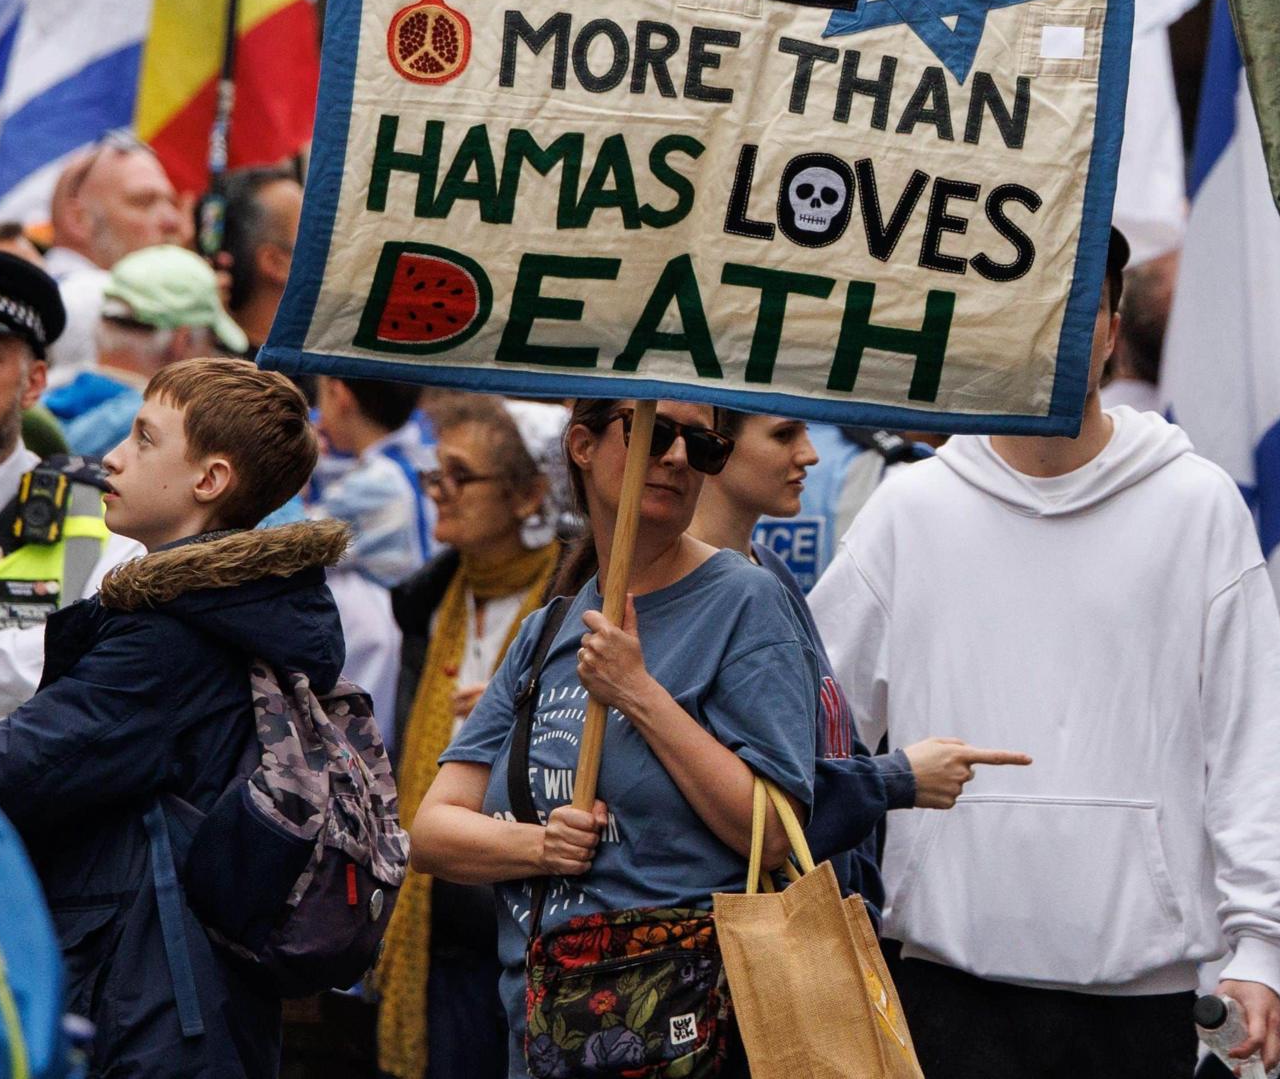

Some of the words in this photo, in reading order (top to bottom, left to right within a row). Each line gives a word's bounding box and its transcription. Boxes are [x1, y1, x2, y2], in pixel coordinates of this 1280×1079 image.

[498, 9, 742, 104] MORE
[777, 37, 1031, 149] THAN
[366, 113, 707, 230] HAMAS
[723, 143, 1043, 283] LOVES
[351, 240, 957, 403] DEATH
